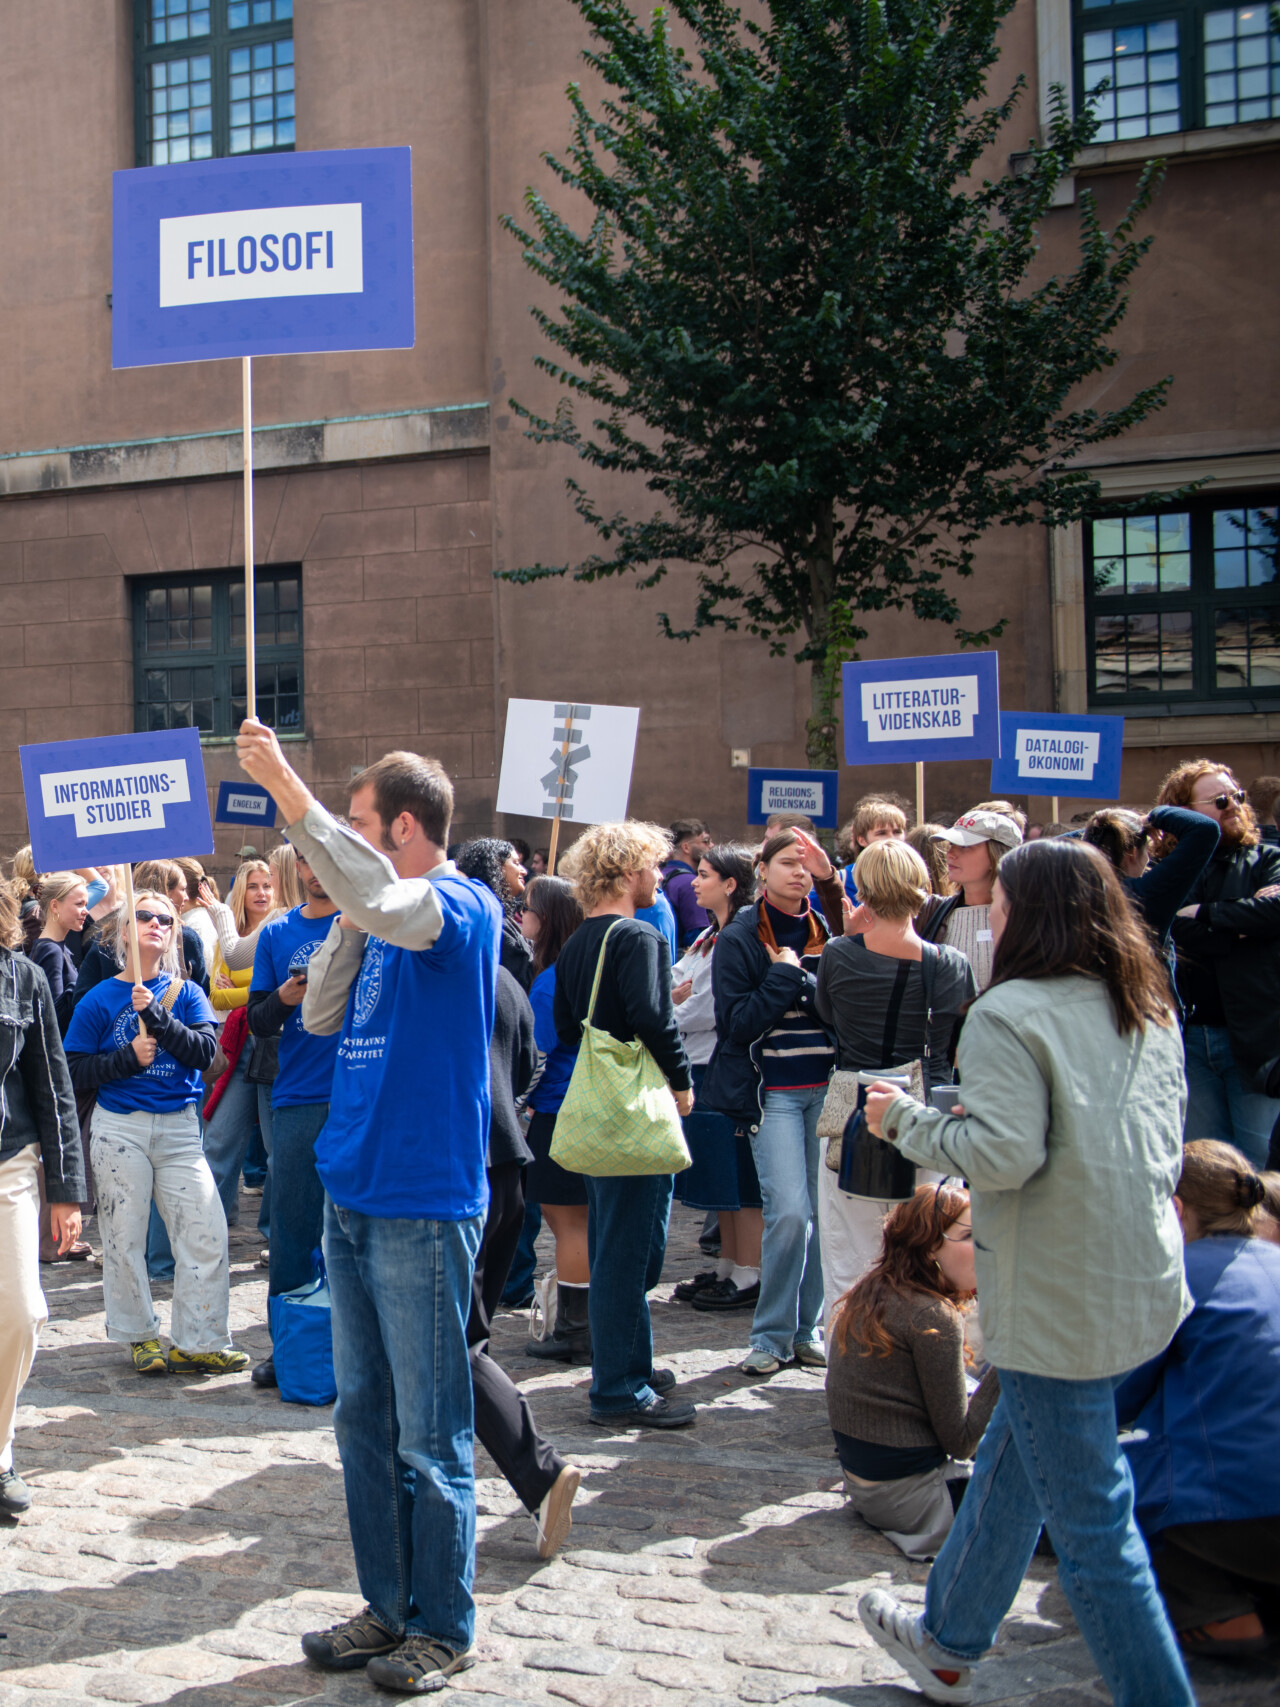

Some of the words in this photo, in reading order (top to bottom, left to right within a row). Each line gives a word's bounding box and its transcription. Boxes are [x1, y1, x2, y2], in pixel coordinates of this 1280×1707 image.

[187, 230, 334, 280] FILOSOFI
[872, 687, 966, 710] LITTERATUR-
[878, 709, 962, 731] VIDENSKAB
[1025, 738, 1089, 755] DATALOGI-
[1028, 755, 1084, 772] ØKONOMI
[54, 772, 177, 804] INFORMATIONS-
[769, 786, 816, 798] RELIGIONS-
[86, 799, 152, 824] STUDIER
[232, 798, 263, 810] ENGELSK
[768, 798, 817, 810] VIDENSKAB
